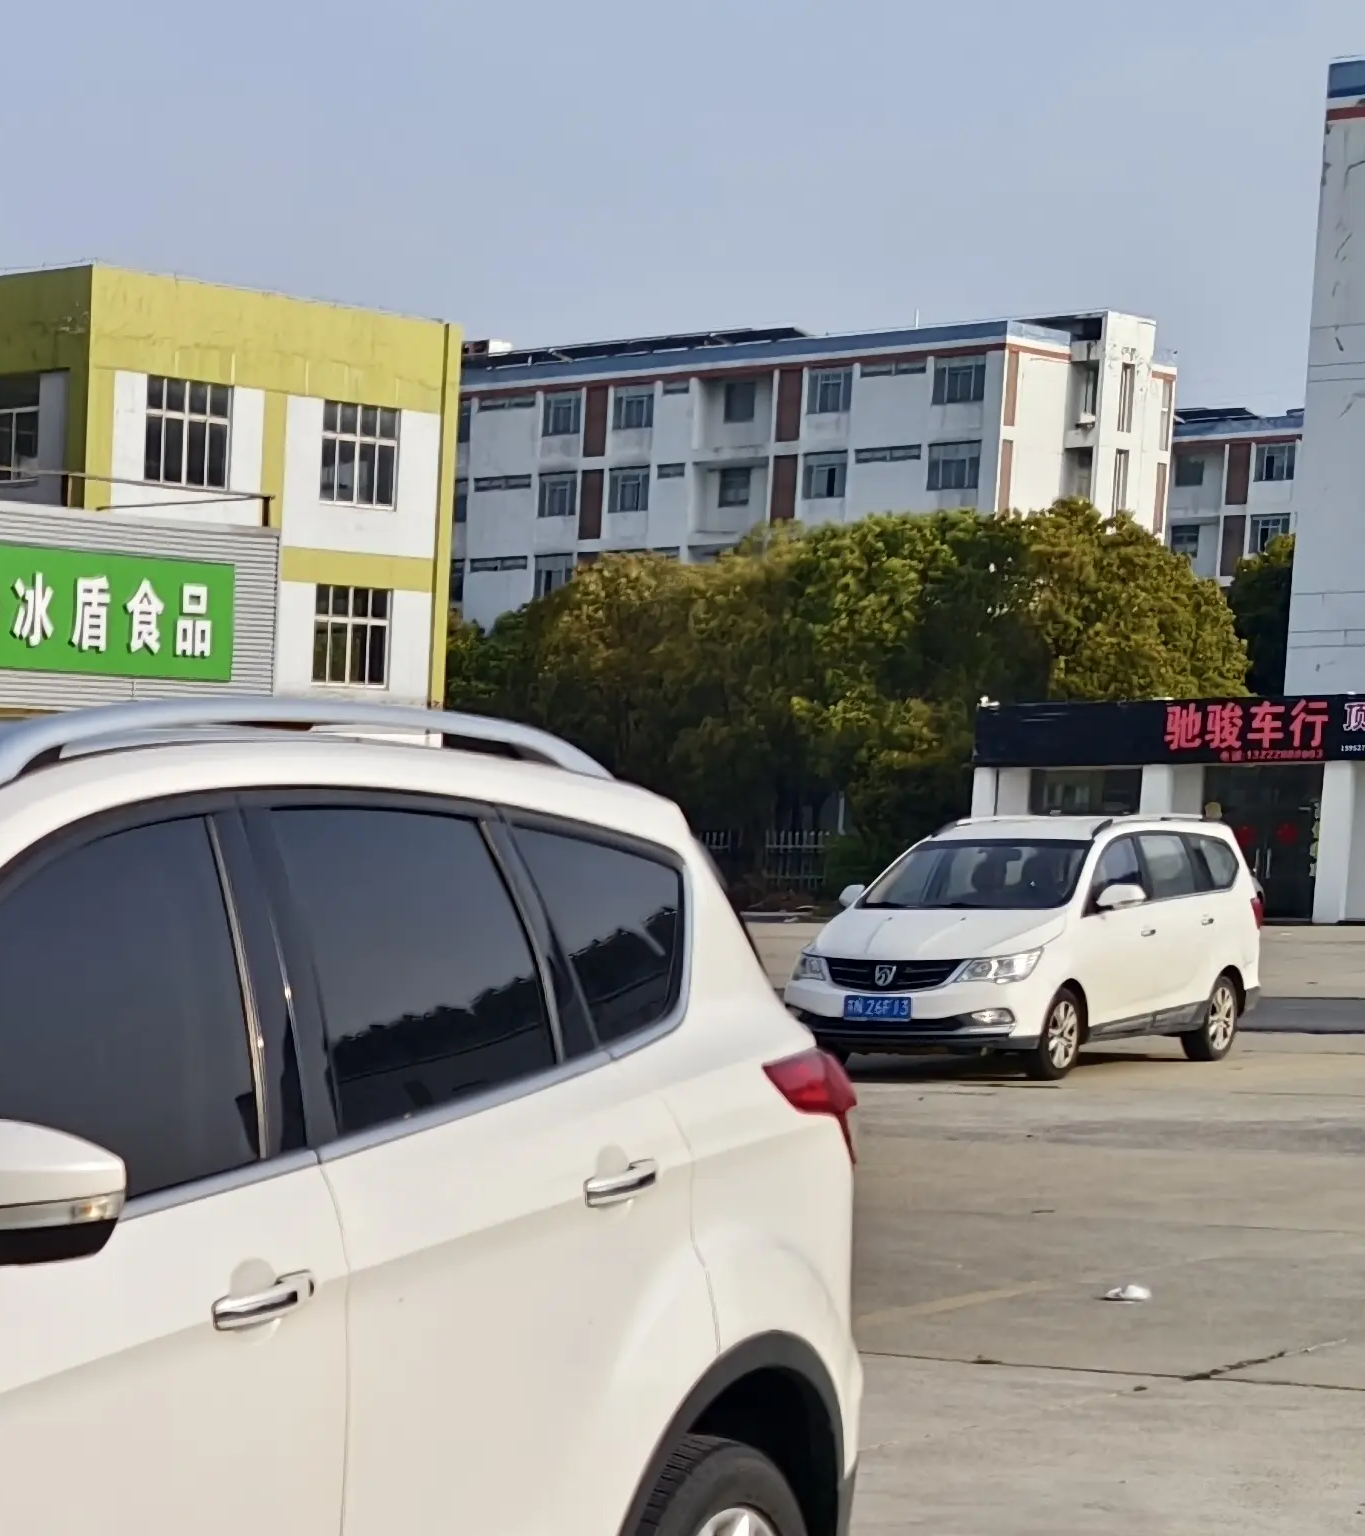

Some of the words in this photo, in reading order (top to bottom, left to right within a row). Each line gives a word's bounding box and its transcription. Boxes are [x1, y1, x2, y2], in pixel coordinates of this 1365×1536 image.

[11, 571, 212, 658] 冰盾食品
[1164, 698, 1330, 750] 驰骏车行
